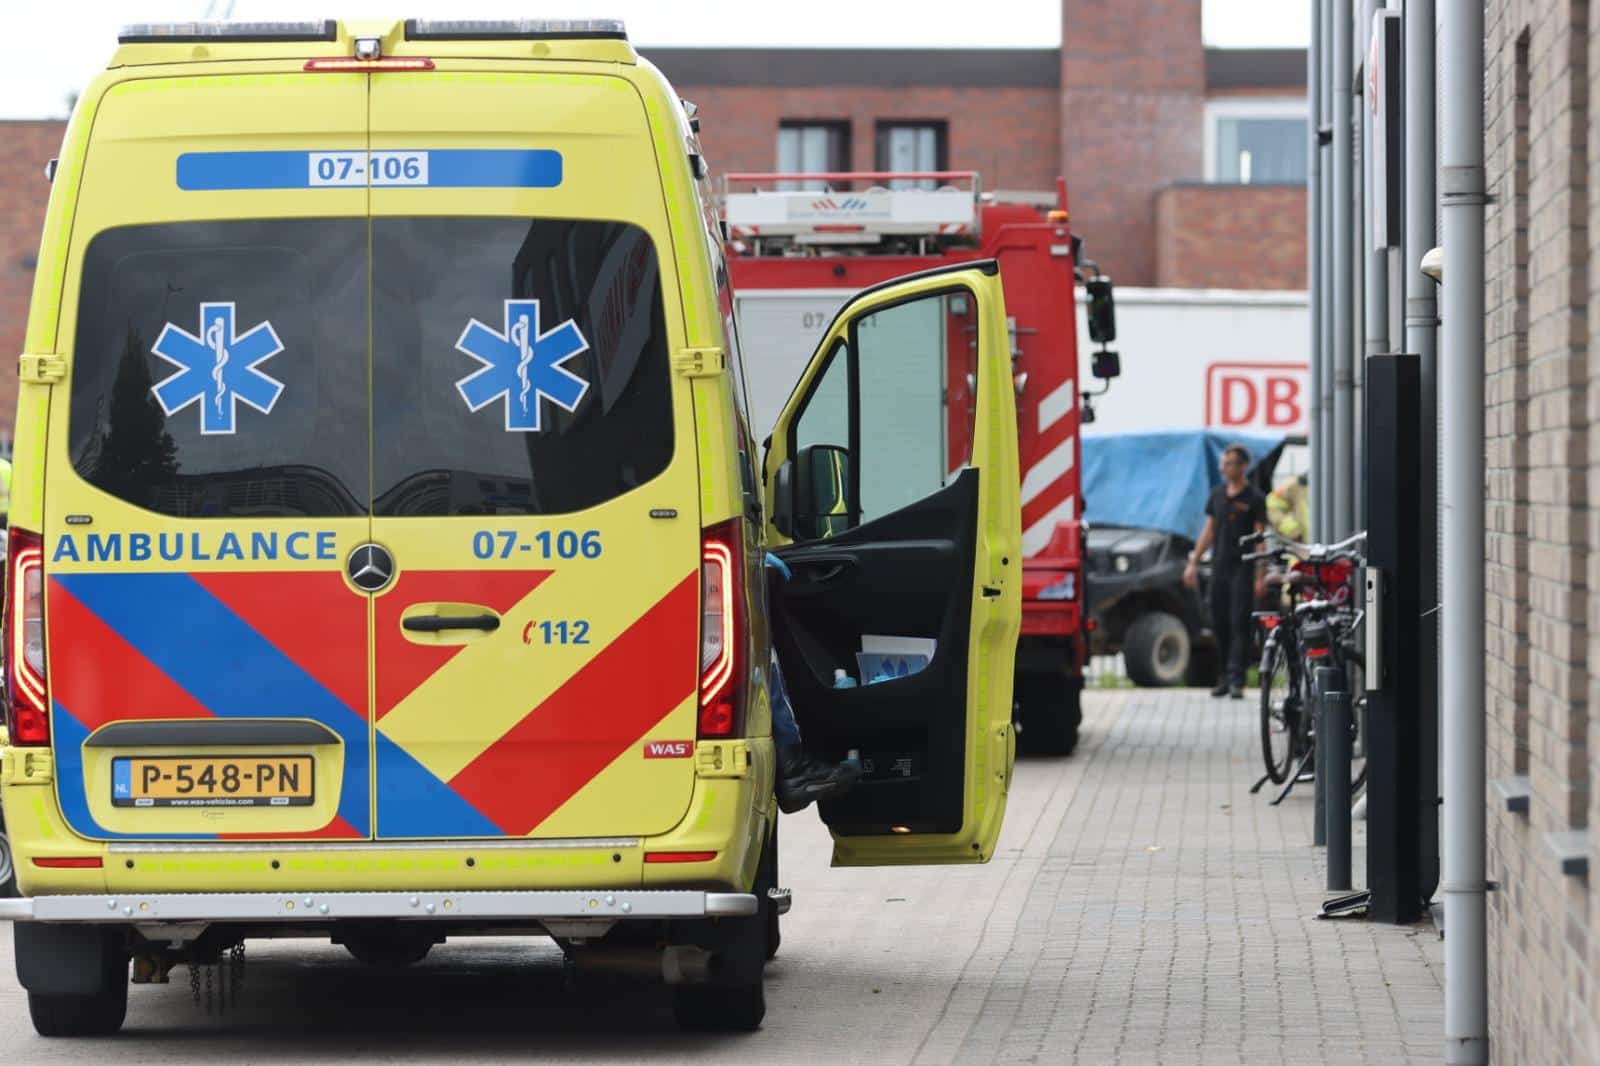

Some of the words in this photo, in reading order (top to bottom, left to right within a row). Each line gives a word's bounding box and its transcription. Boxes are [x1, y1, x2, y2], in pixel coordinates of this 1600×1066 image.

[317, 157, 421, 181] 07-106
[1220, 376, 1302, 426] DB
[52, 531, 337, 562] AMBULANCE
[472, 530, 602, 559] 07-106
[650, 743, 686, 755] WAS
[115, 783, 129, 793] NL
[142, 763, 299, 794] P-548-PN
